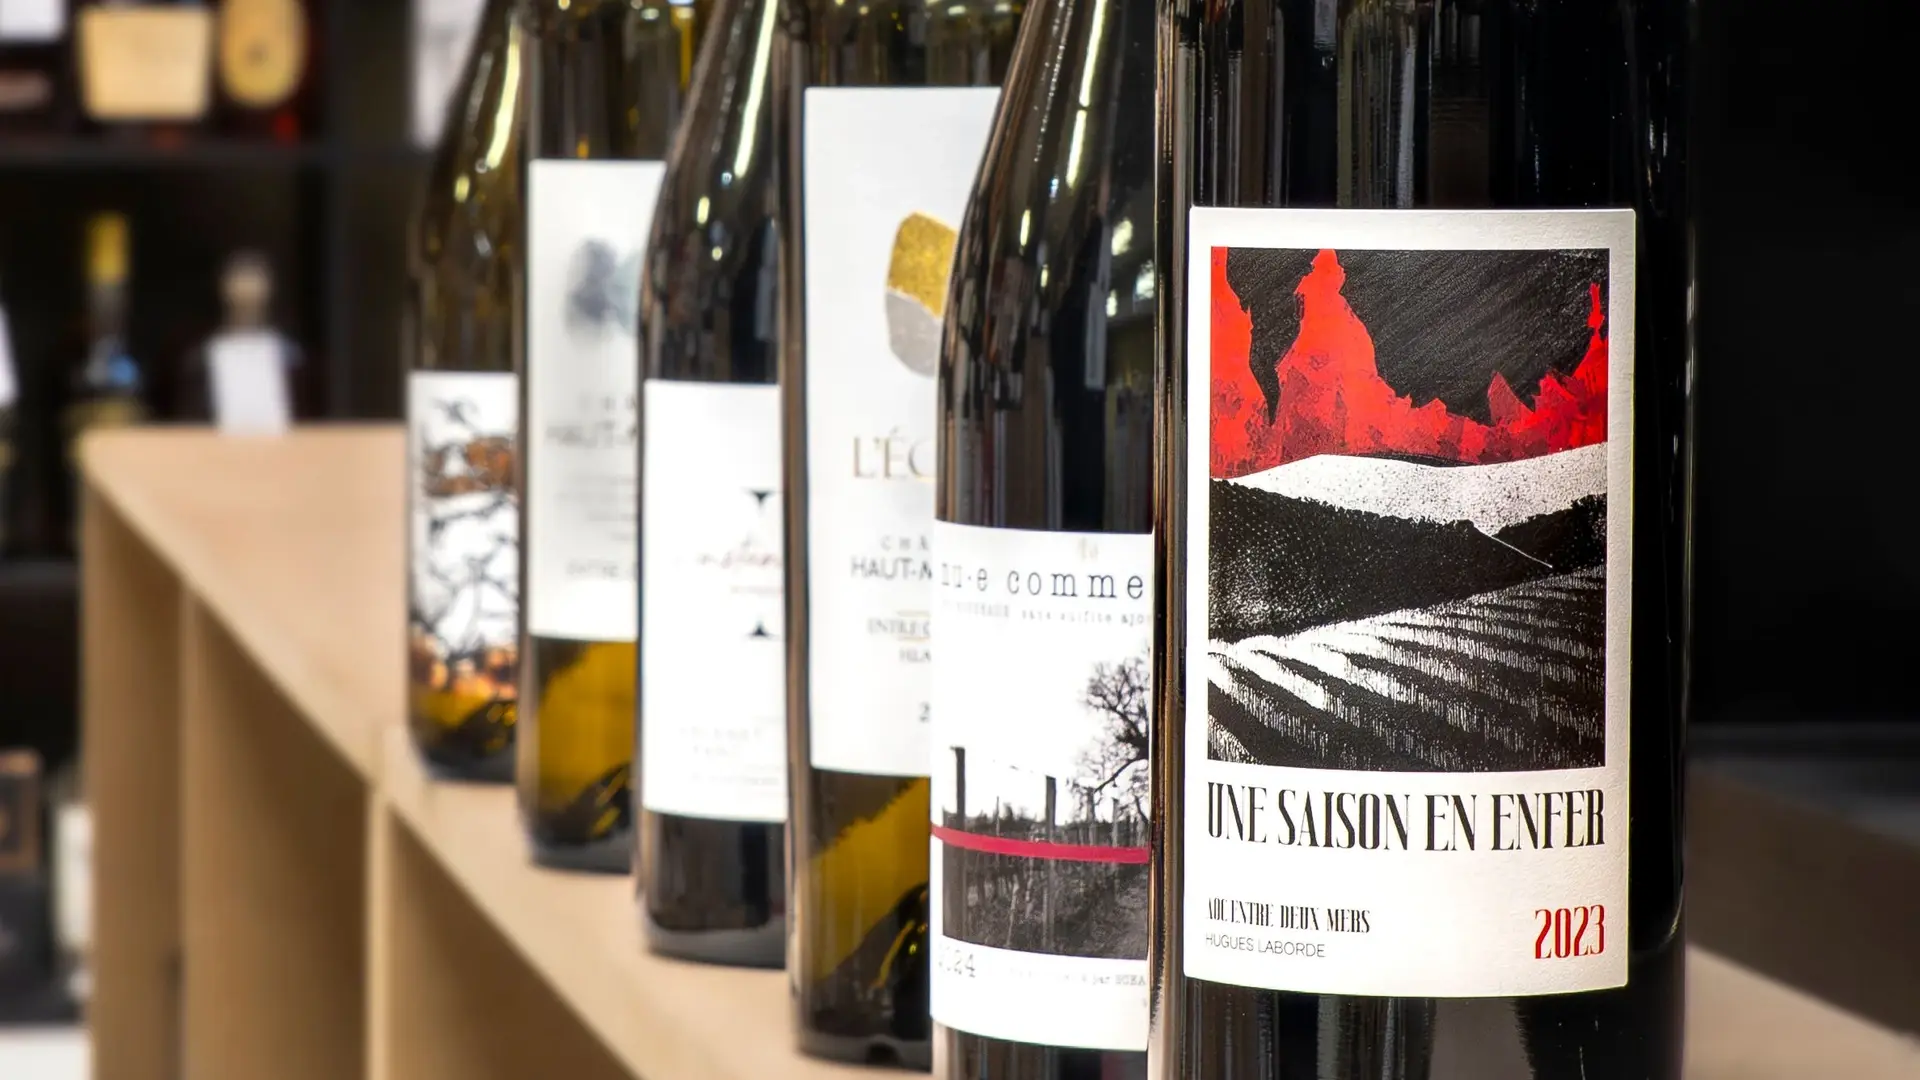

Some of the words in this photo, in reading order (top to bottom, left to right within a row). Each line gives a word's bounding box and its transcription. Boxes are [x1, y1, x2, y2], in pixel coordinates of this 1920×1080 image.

[1007, 570, 1144, 600] comme
[1208, 781, 1268, 844] UNE
[1278, 788, 1411, 851] SAISON
[1425, 794, 1477, 851] EN
[1491, 787, 1606, 851] ENFER
[1231, 899, 1275, 928] ENTRE
[1280, 905, 1320, 931] DEUX
[1327, 908, 1371, 934] MERS
[1534, 904, 1606, 960] 2023
[1205, 932, 1254, 952] HUGUES
[1258, 940, 1326, 958] LABORDE
